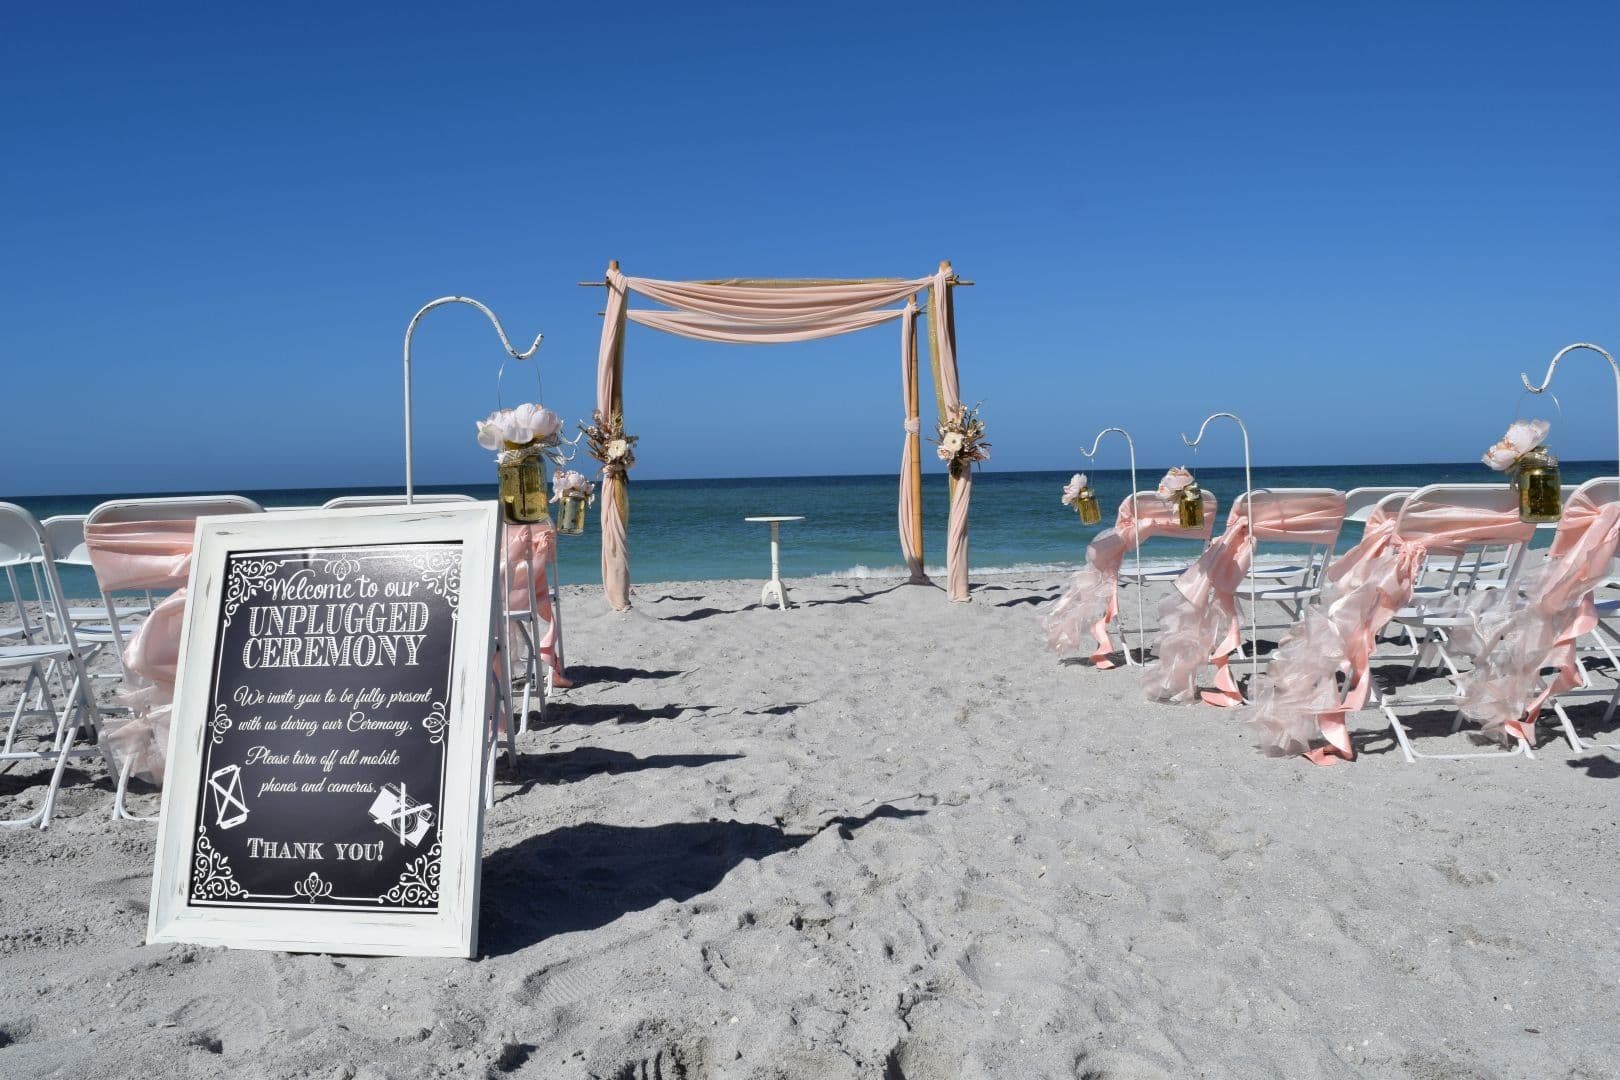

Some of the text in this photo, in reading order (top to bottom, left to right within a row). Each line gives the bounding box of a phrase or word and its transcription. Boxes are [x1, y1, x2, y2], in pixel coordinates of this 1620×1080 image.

[264, 569, 419, 600] Welcome to our
[249, 602, 429, 636] UNPLUGGED
[242, 635, 427, 669] CEREMONY
[233, 686, 432, 709] We invite you to be fully present
[238, 711, 413, 736] with us during our Ceremony.
[245, 746, 400, 772] Please turn off all mobile
[257, 777, 377, 797] phones and cameras.
[247, 838, 384, 861] THANK YOU!
